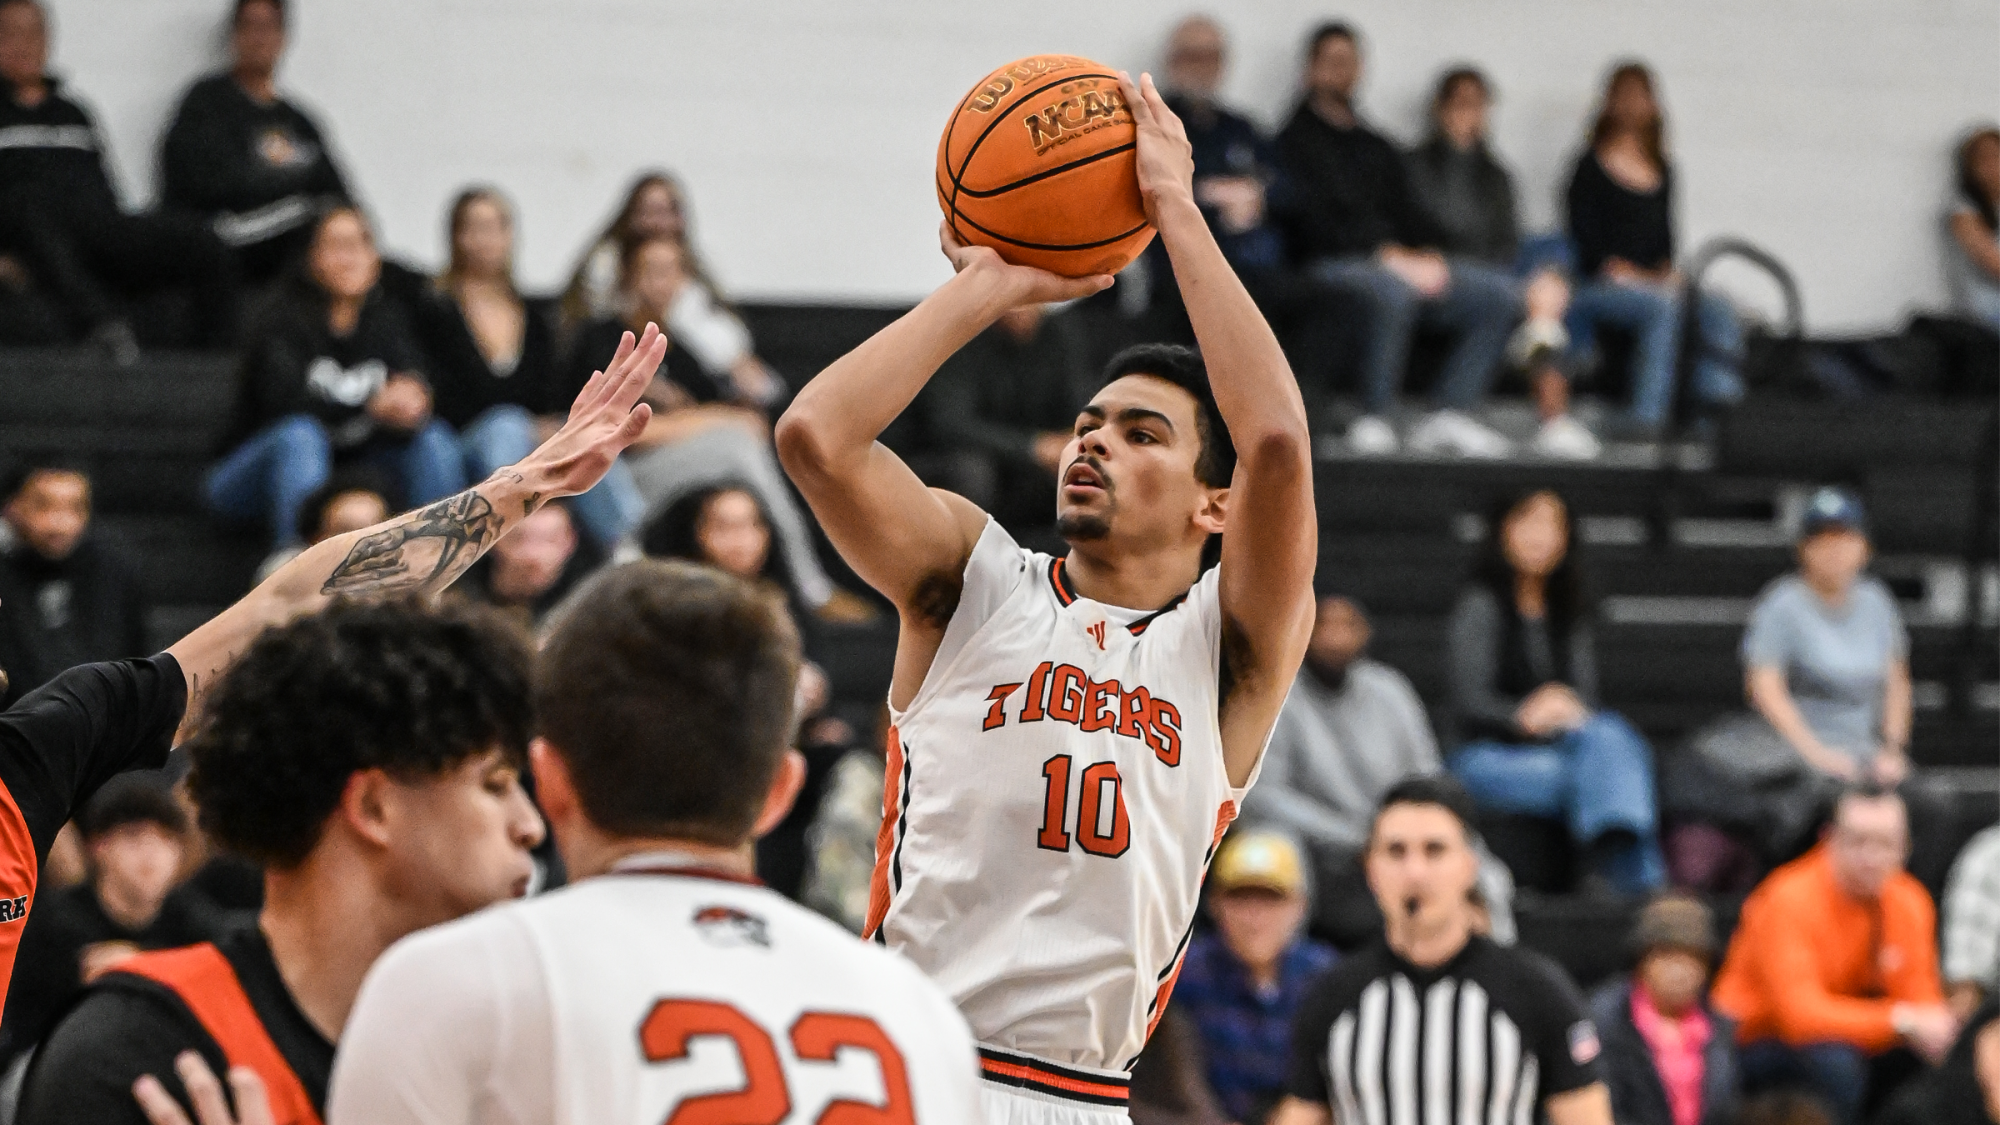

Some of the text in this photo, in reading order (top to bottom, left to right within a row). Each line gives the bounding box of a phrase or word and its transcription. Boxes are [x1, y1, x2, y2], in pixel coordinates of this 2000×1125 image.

[1023, 88, 1128, 150] NCAA
[982, 661, 1182, 768] TIGERS
[1037, 754, 1131, 859] 10
[635, 996, 918, 1125] 22
